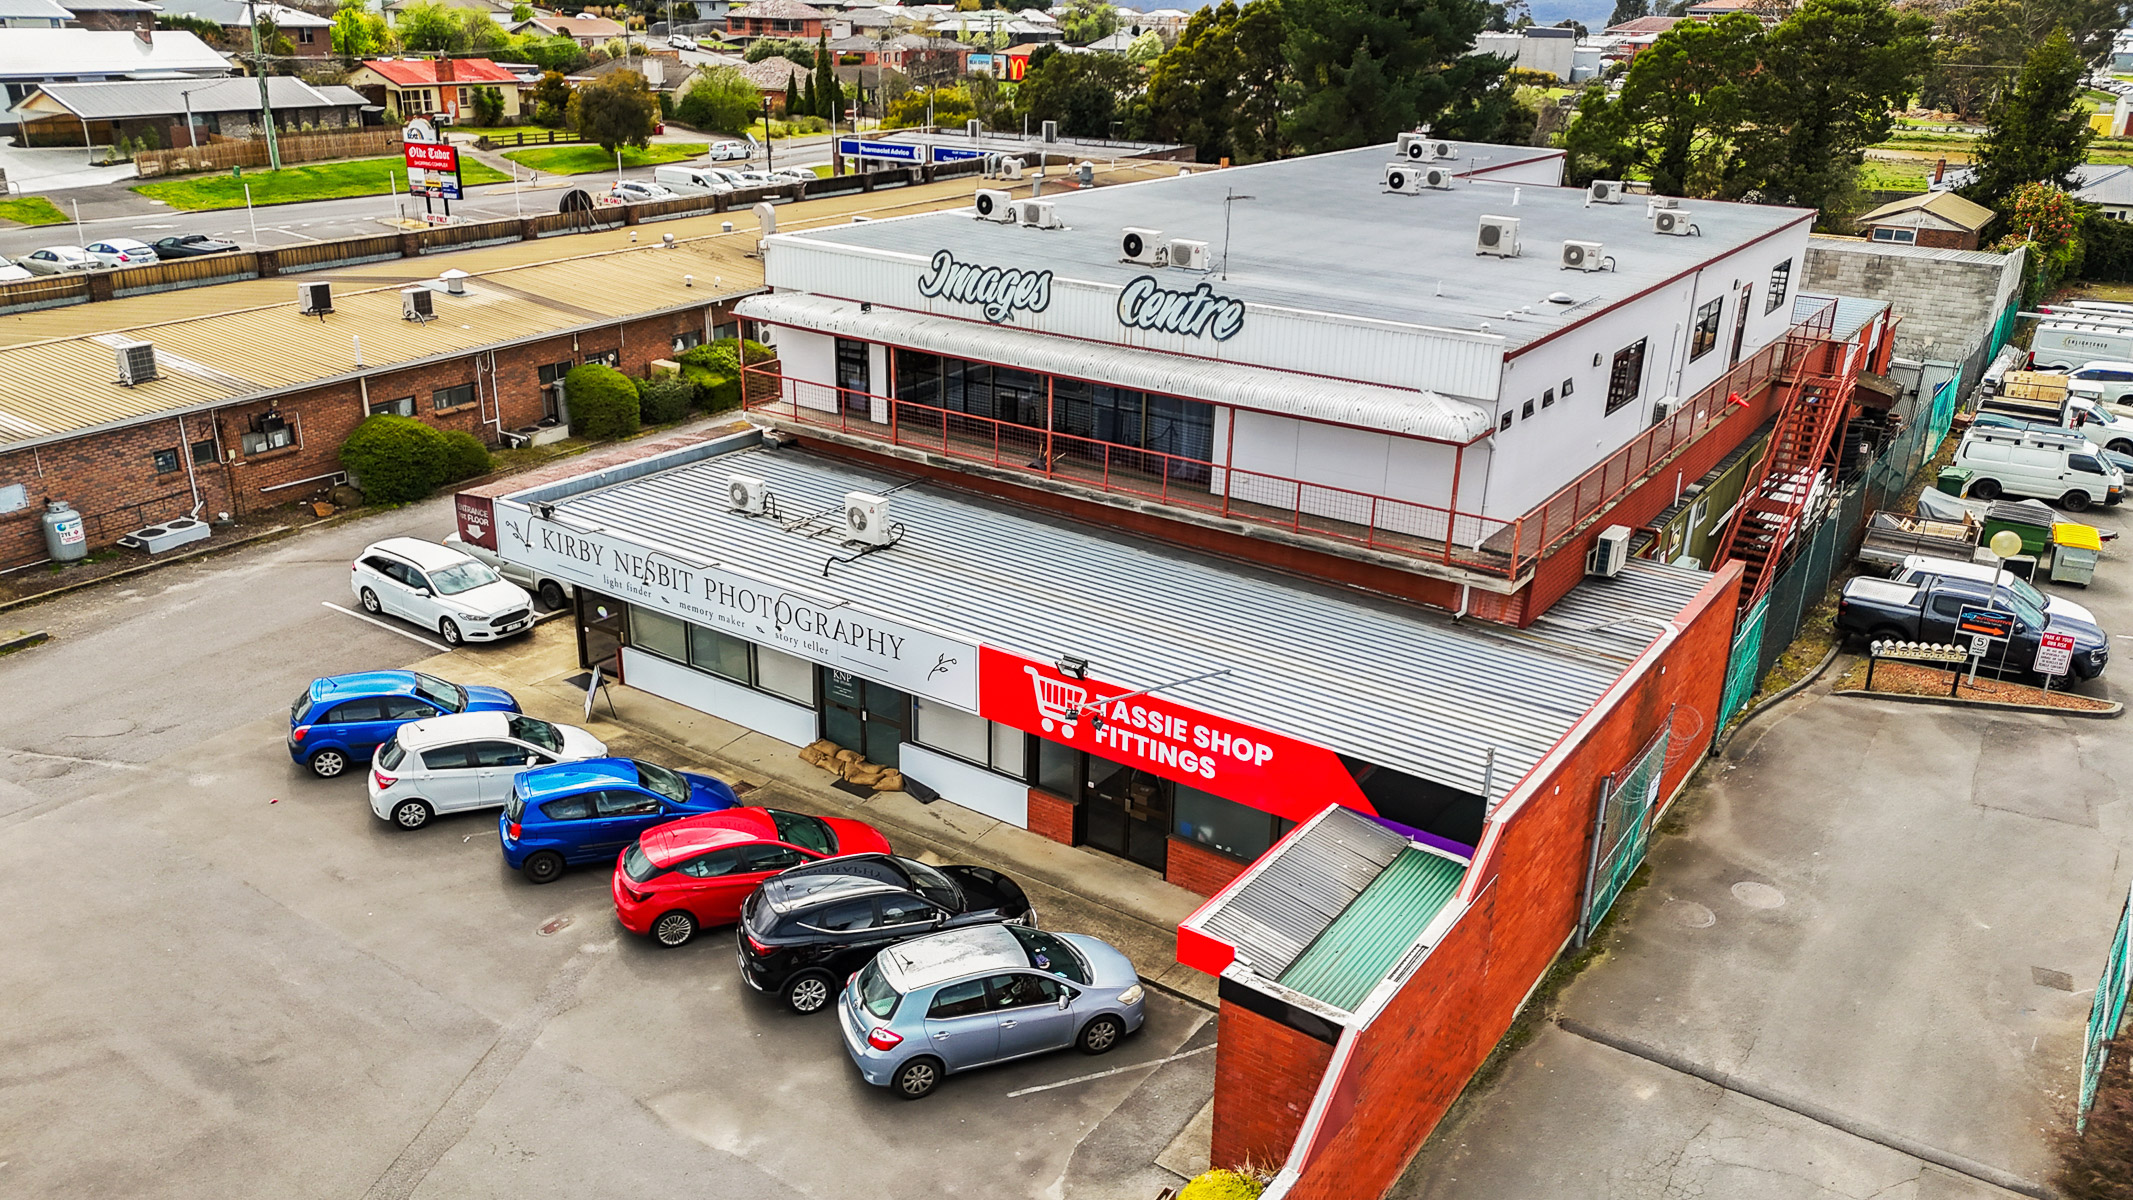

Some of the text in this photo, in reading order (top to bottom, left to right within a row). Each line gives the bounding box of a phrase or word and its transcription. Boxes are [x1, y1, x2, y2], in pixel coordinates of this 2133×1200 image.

[408, 146, 450, 160] Olde Tudor
[861, 146, 910, 156] Pharmacist Advice
[919, 250, 1245, 342] Images Centre
[457, 503, 489, 518] ENTRANCE
[467, 514, 489, 526] FLOOR
[541, 528, 905, 661] KIRBY NESBIT PHOTOGRAPHY
[603, 574, 828, 655] light finder memory maker story teller
[1976, 616, 2012, 626] AUTOMOTIVE
[1976, 637, 1985, 647] 5
[833, 669, 852, 683] KNP
[1095, 694, 1273, 766] TASSIE SHOP
[1095, 723, 1216, 779] FITTINGS
